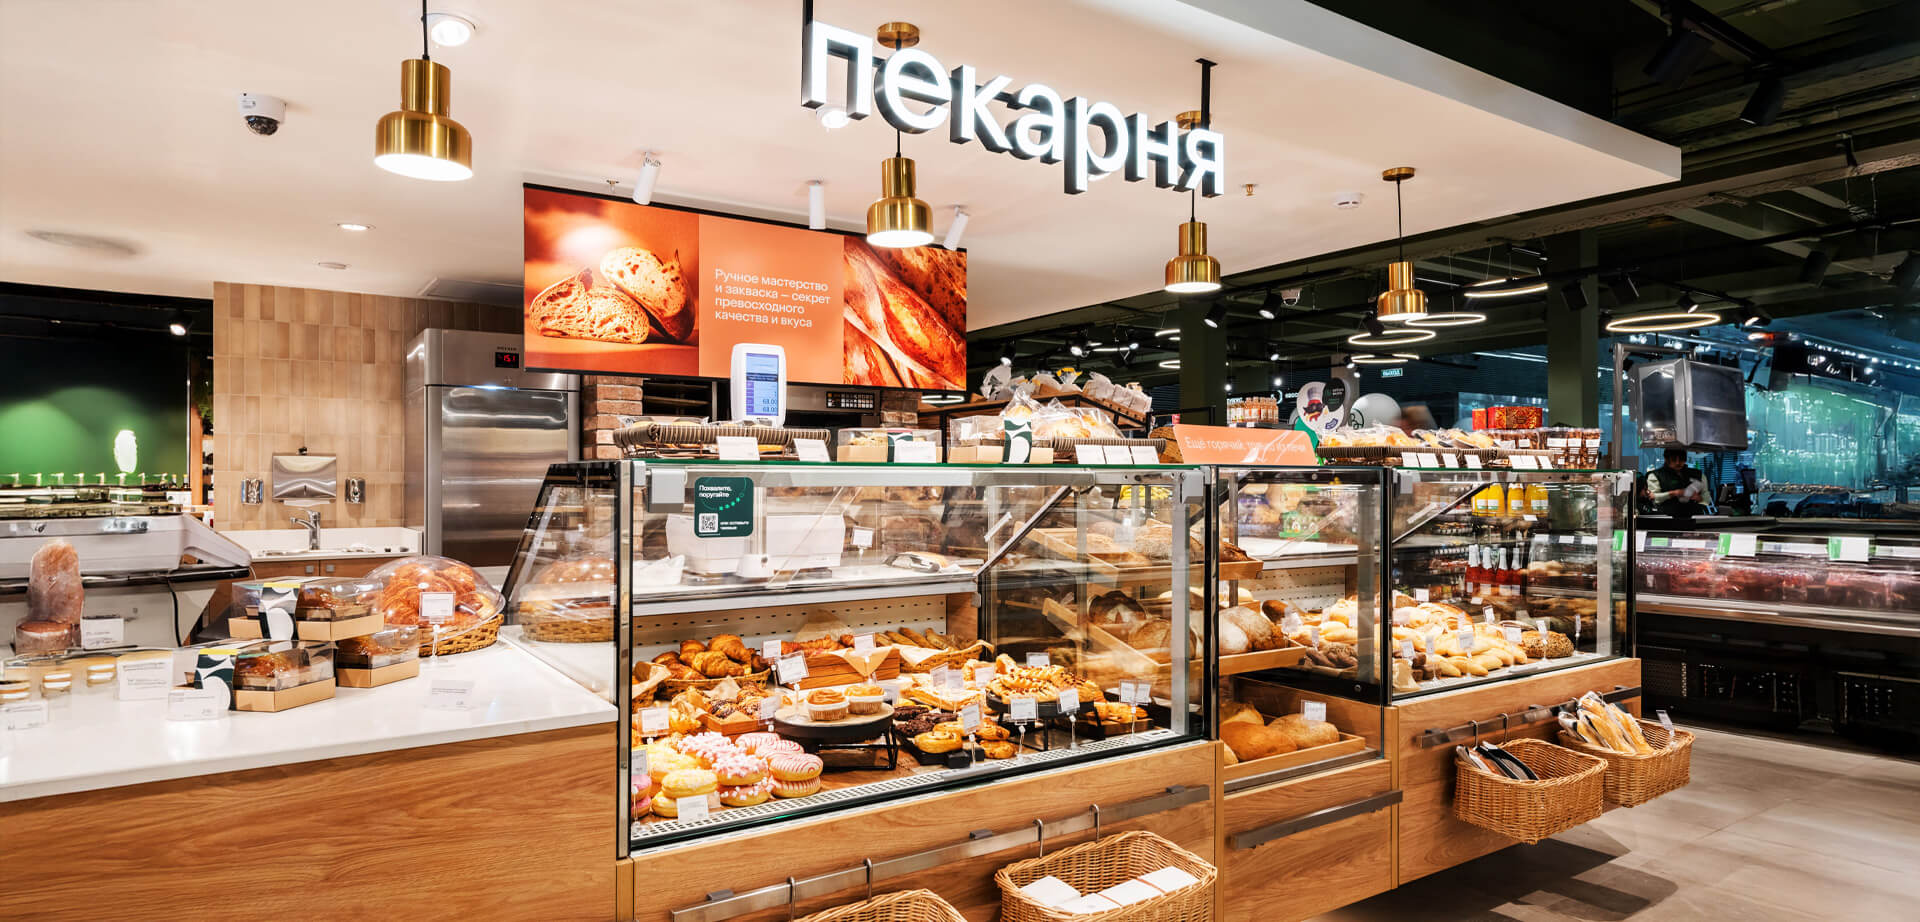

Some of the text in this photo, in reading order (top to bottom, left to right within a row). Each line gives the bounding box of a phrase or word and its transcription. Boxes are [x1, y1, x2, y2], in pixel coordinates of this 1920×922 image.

[809, 20, 1224, 196] пекарня
[715, 268, 829, 292] Ручное мастерство
[714, 284, 723, 294] и
[725, 285, 779, 299] закваска
[791, 293, 831, 304] секрет
[714, 298, 805, 314] превосходного
[714, 311, 813, 328] качества и вкуса
